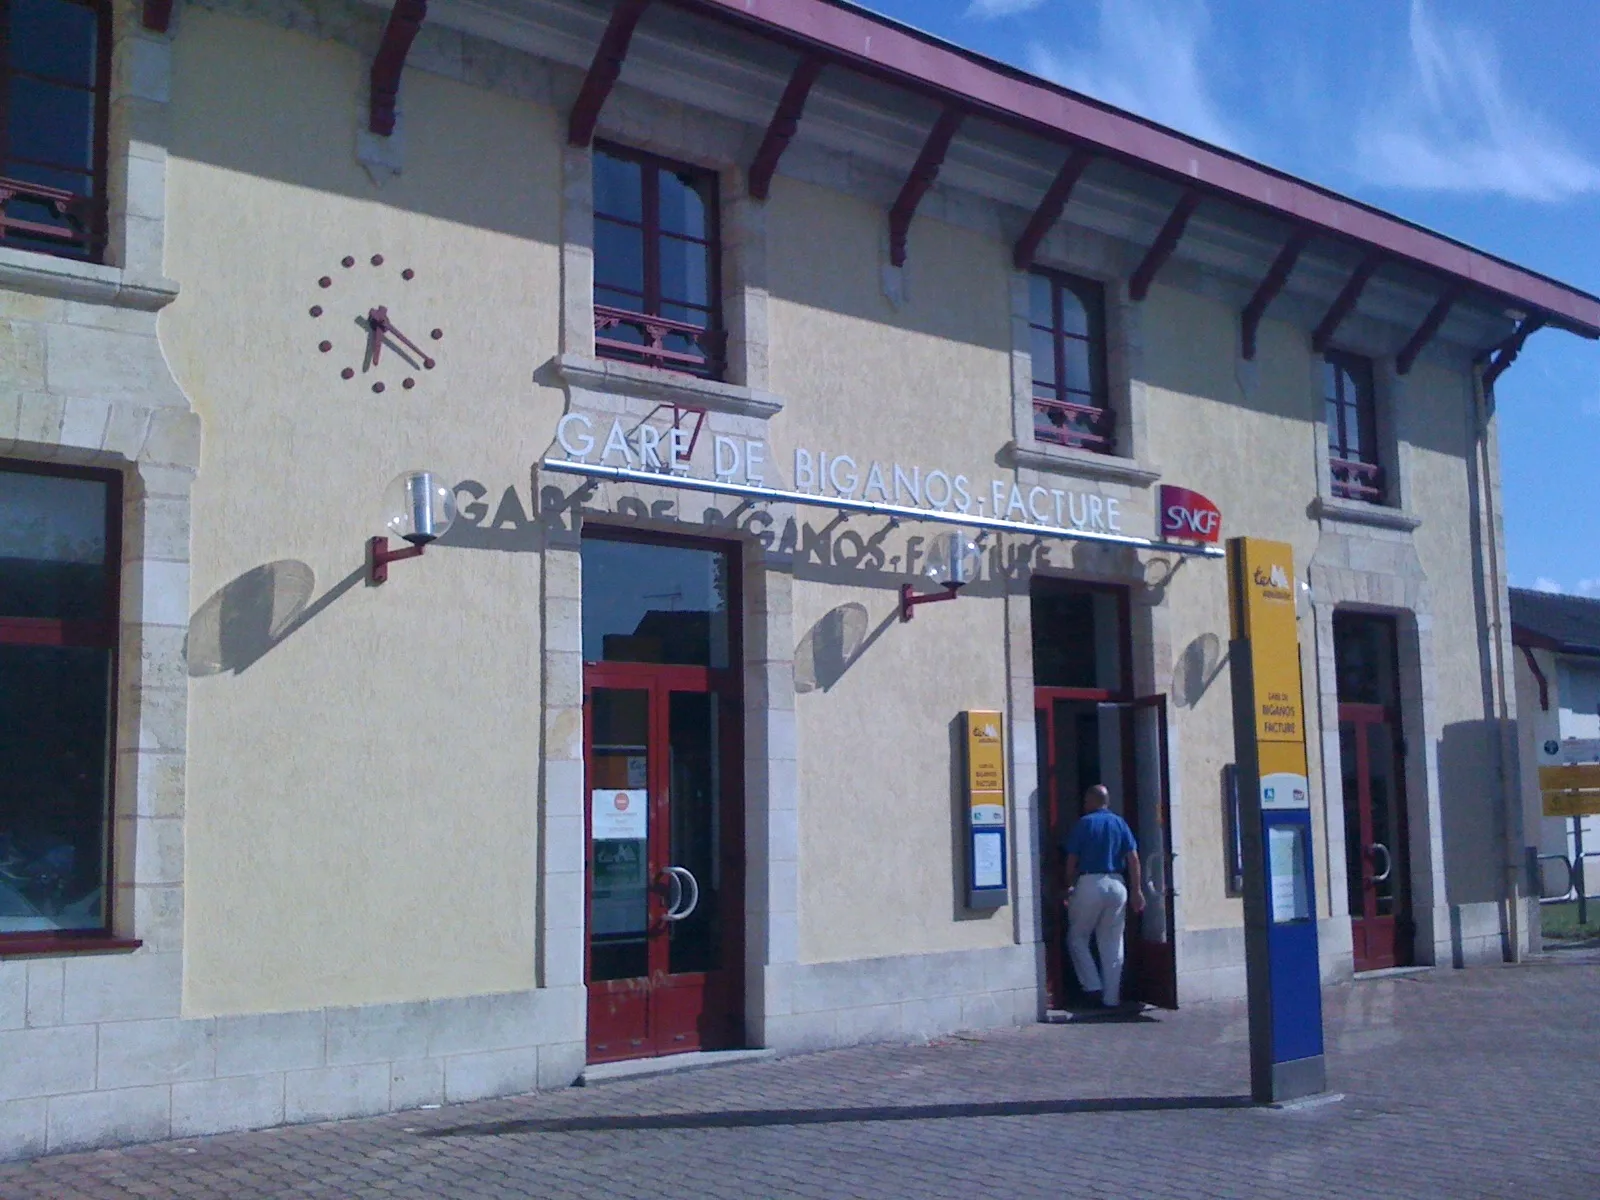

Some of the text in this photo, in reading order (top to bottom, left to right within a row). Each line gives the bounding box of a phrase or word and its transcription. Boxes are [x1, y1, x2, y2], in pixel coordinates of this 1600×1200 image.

[557, 412, 691, 471] GARE
[714, 435, 765, 482] DE
[1165, 505, 1220, 534] SNCF
